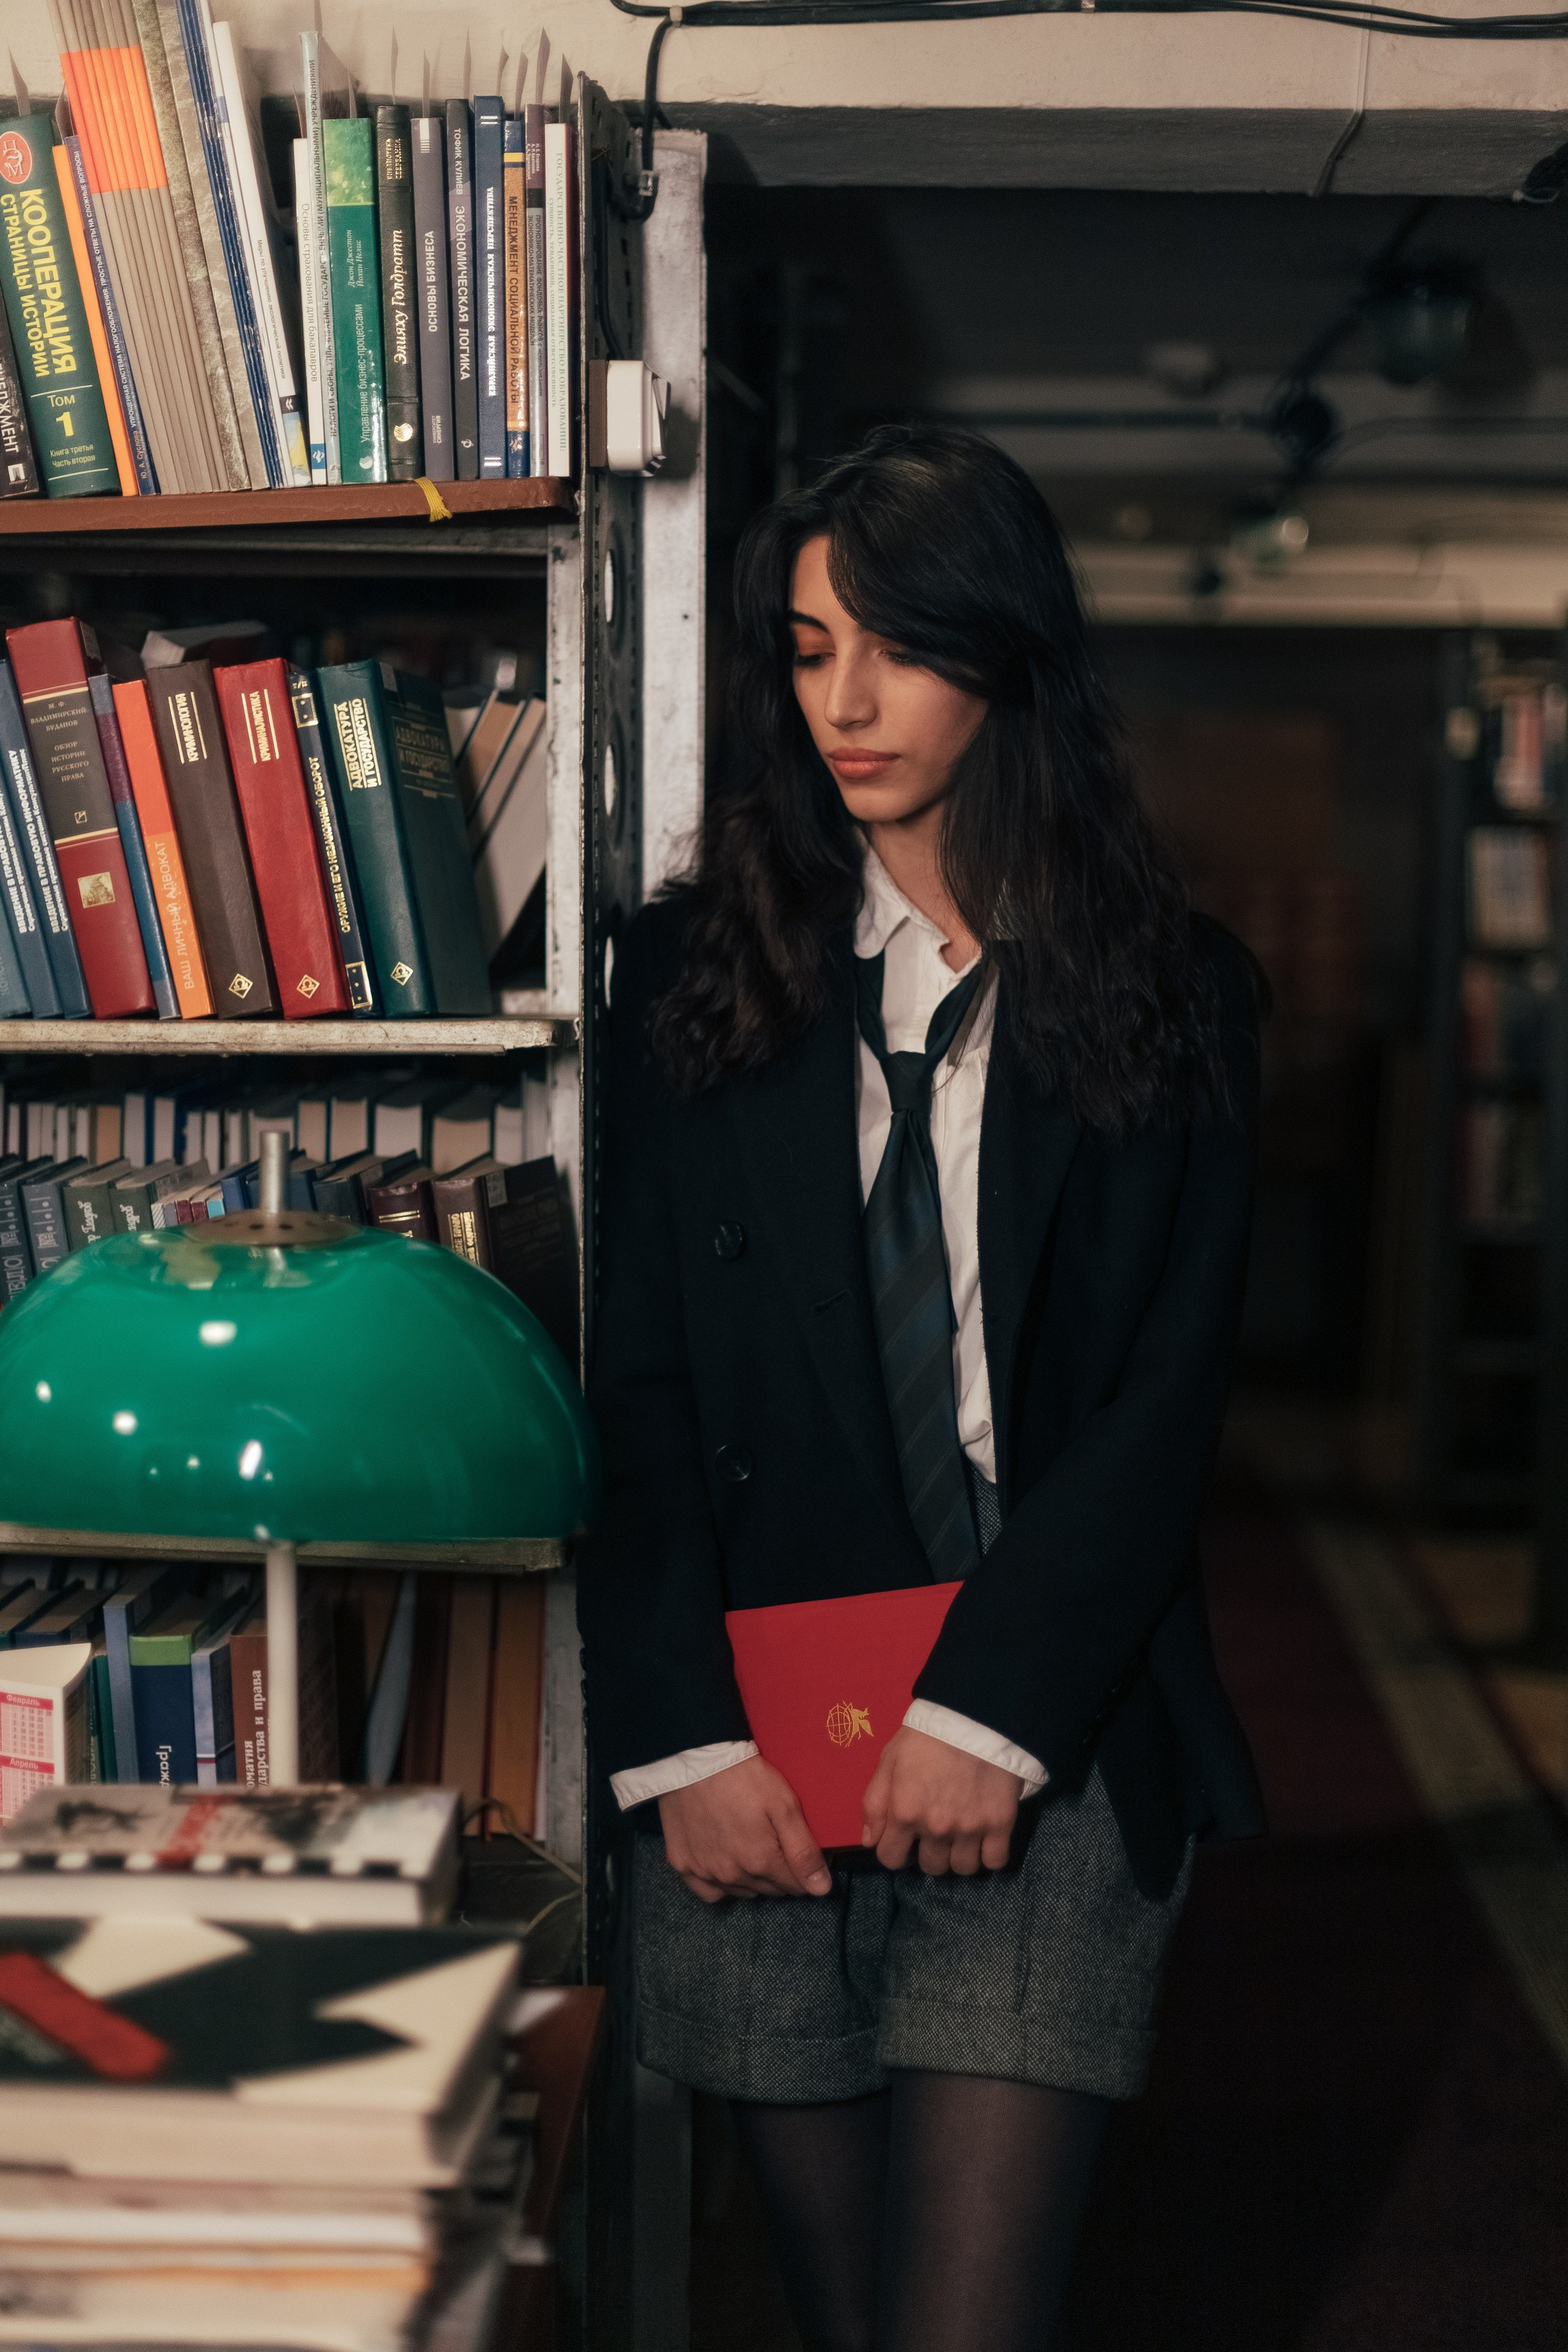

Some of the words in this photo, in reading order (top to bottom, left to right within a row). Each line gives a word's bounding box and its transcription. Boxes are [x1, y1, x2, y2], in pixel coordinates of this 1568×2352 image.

[309, 60, 318, 126] УЧРЕЖДЕНИЯМИ
[74, 151, 86, 184] ВОПРОСЫ
[311, 127, 325, 215] (МУНИЦИПАЛЬНЫМИ)
[81, 184, 92, 217] СЛОЖНЫЕ
[89, 217, 97, 227] НА
[301, 203, 311, 243] Основы
[90, 228, 101, 254] ОТВЕТЫ
[508, 195, 519, 274] МЕНЕДЖМЕНТ
[556, 153, 564, 295] ГОСУДАРСТВЕННО-ЧАСТНОЕ
[96, 255, 107, 286] ПРОСТЫЕ
[305, 243, 314, 304] страхования
[347, 265, 356, 288] Джон
[356, 262, 364, 287] Йохан
[390, 230, 407, 306] Голдратт
[425, 230, 436, 282] БИЗНЕСА
[455, 206, 469, 323] ЭКОНОМИЧЕСКАЯ
[1, 194, 33, 291] СТРАНИЦЫ
[20, 295, 50, 377] ИСТОРИИ
[20, 189, 77, 374] КООПЕРАЦИЯ
[102, 286, 123, 354] НАЛОГООБЛОЖЕНИЯ:
[262, 268, 272, 303] улучшению
[268, 303, 280, 349] экологической
[277, 349, 286, 379] политики
[428, 285, 438, 333] ОСНОВЫ
[509, 277, 519, 355] СОЦИАЛЬНОЙ
[308, 325, 317, 382] бакалавров
[355, 304, 368, 390] бизнес-процессами
[394, 309, 409, 364] Элияху
[459, 327, 470, 380] ЛОГИКА
[117, 355, 127, 384] СИСТЕМА
[487, 335, 497, 396] ЕВРАЗИЙСКАЯ
[510, 357, 520, 404] РАБОТЫ
[47, 394, 75, 407] Том
[123, 385, 137, 428] УПРОЩЕННАЯ
[360, 391, 371, 444] Управление
[56, 412, 74, 437] 1
[133, 431, 144, 460] Суслова
[50, 448, 69, 457] Книга
[70, 443, 94, 454] третья
[52, 459, 71, 468] Часть
[72, 454, 96, 465] вторая
[45, 720, 78, 732] БУДАНОВ
[54, 741, 78, 751] ОБЗОР
[175, 693, 200, 762] КРИМИНОЛОГИЯ
[249, 691, 271, 762] КРИМИНАЛИСТИКА
[337, 701, 363, 789] АДВОКАТУРА
[352, 698, 375, 776] ГОСУДАРСТВО
[51, 750, 86, 763] ИСТОРИИ
[51, 760, 89, 774] РУССКОГО
[61, 772, 85, 782] ПРАВА
[309, 757, 325, 796] ОБОРОТ
[9, 749, 34, 823] ИНФОРМАТИКУ
[20, 748, 40, 816] КонсультантПлюс
[366, 778, 378, 788] И
[2, 815, 15, 847] системы
[26, 823, 47, 878] ПРАВОВУЮ
[36, 815, 48, 847] системы
[315, 796, 338, 865] НЕЗАКОННЫЙ
[7, 878, 15, 886] В
[10, 846, 24, 884] правовые
[40, 878, 48, 886] В
[43, 846, 58, 884] правовые
[154, 842, 178, 900] АДВОКАТ
[330, 864, 342, 883] ЕГО
[9, 886, 27, 933] ВВЕДЕНИЕ
[20, 884, 35, 932] Справочные
[42, 886, 61, 933] ВВЕДЕНИЕ
[53, 884, 69, 932] Справочные
[167, 902, 188, 957] ЛИЧНЫЙ
[334, 891, 351, 933] ОРУЖИЕ
[181, 960, 195, 990] ВАШ
[6, 1694, 40, 1706] Февраль
[252, 1670, 266, 1711] права
[255, 1716, 263, 1725] и
[10, 1758, 39, 1770] Апрель
